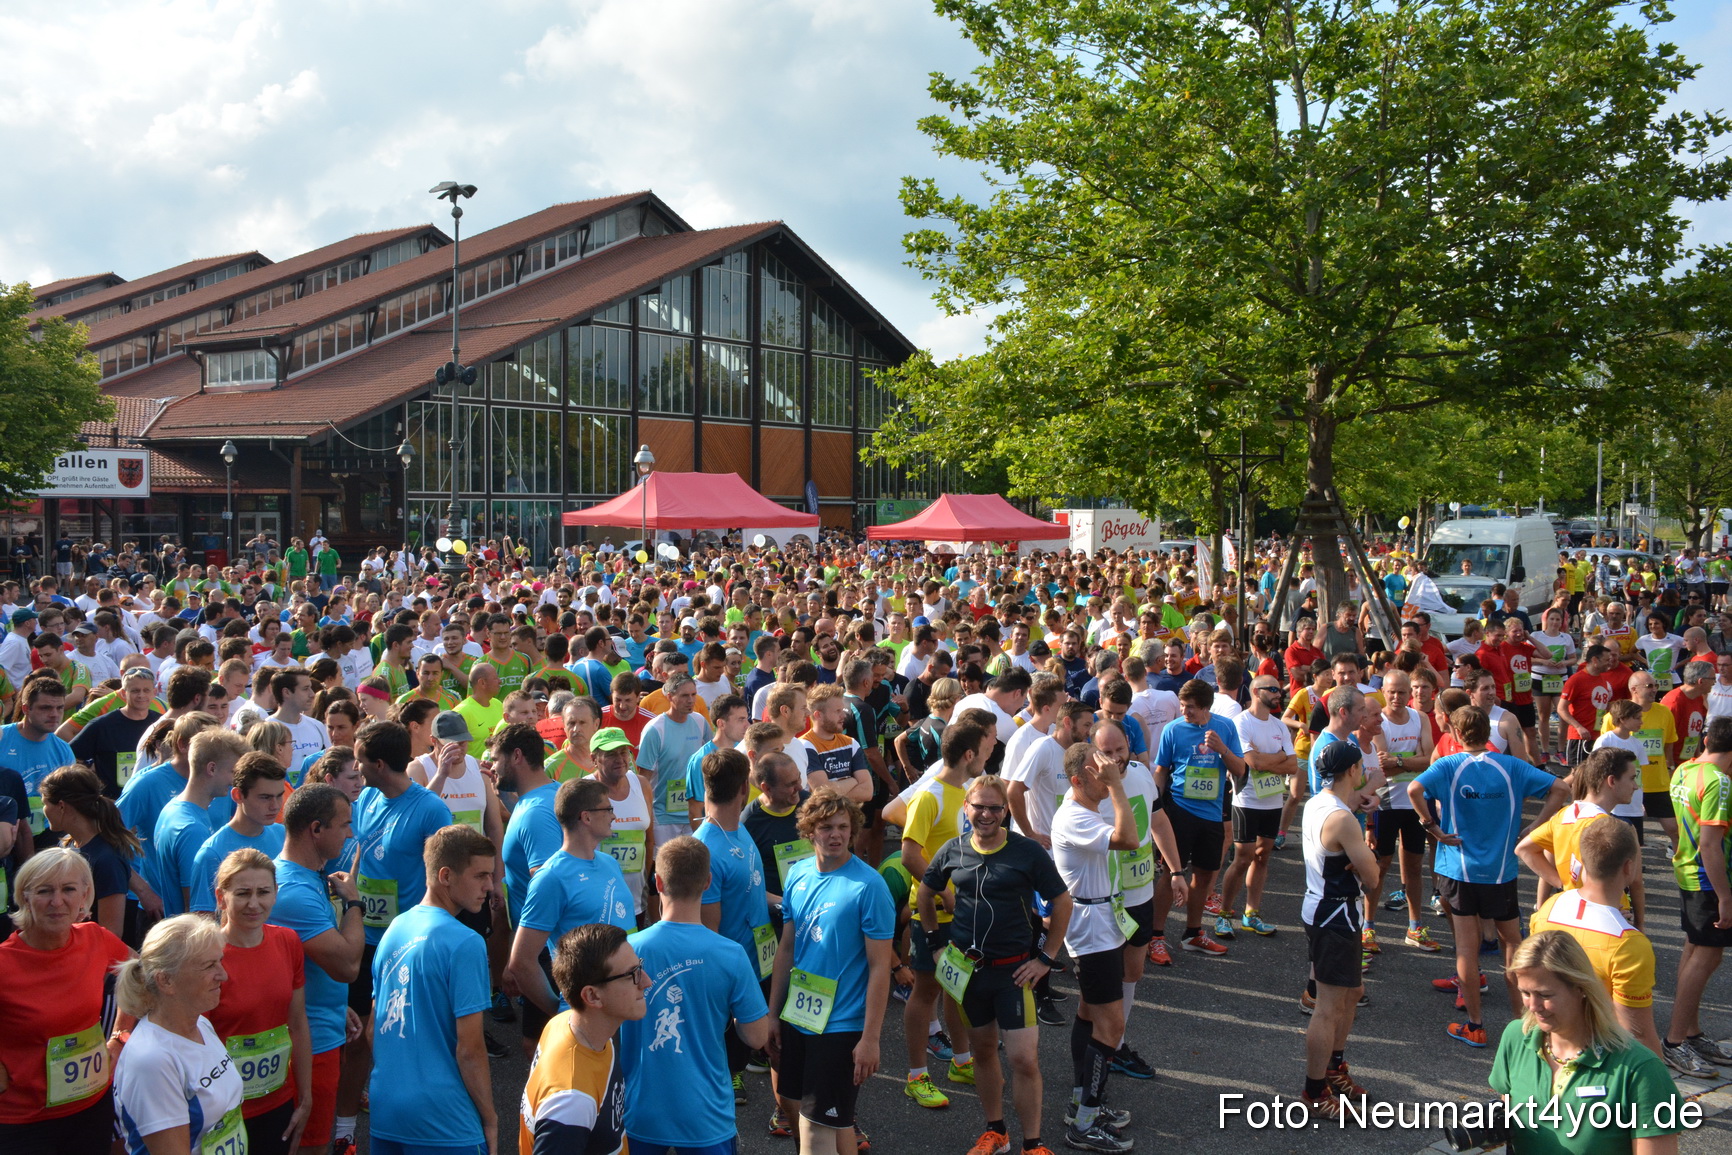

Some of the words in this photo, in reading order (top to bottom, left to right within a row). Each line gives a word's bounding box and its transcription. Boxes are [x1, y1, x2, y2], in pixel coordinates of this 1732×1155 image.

[62, 475, 79, 483] grüßt
[1101, 518, 1150, 543] Bögerl
[1514, 660, 1528, 671] 48
[1546, 681, 1560, 689] 117
[1594, 692, 1607, 704] 48
[1689, 721, 1702, 733] 48
[1643, 739, 1661, 749] 475
[1191, 780, 1213, 791] 456
[1258, 776, 1281, 789] 1439
[1480, 792, 1505, 800] classic
[611, 846, 637, 861] 573
[1130, 859, 1151, 877] 100
[762, 942, 776, 962] 810
[643, 979, 658, 999] eam
[656, 962, 684, 980] Schick
[685, 958, 705, 966] Bau
[940, 960, 960, 986] 781
[795, 991, 823, 1016] 813
[63, 1051, 102, 1084] 970
[199, 1052, 234, 1088] DELPH
[241, 1053, 281, 1082] 969
